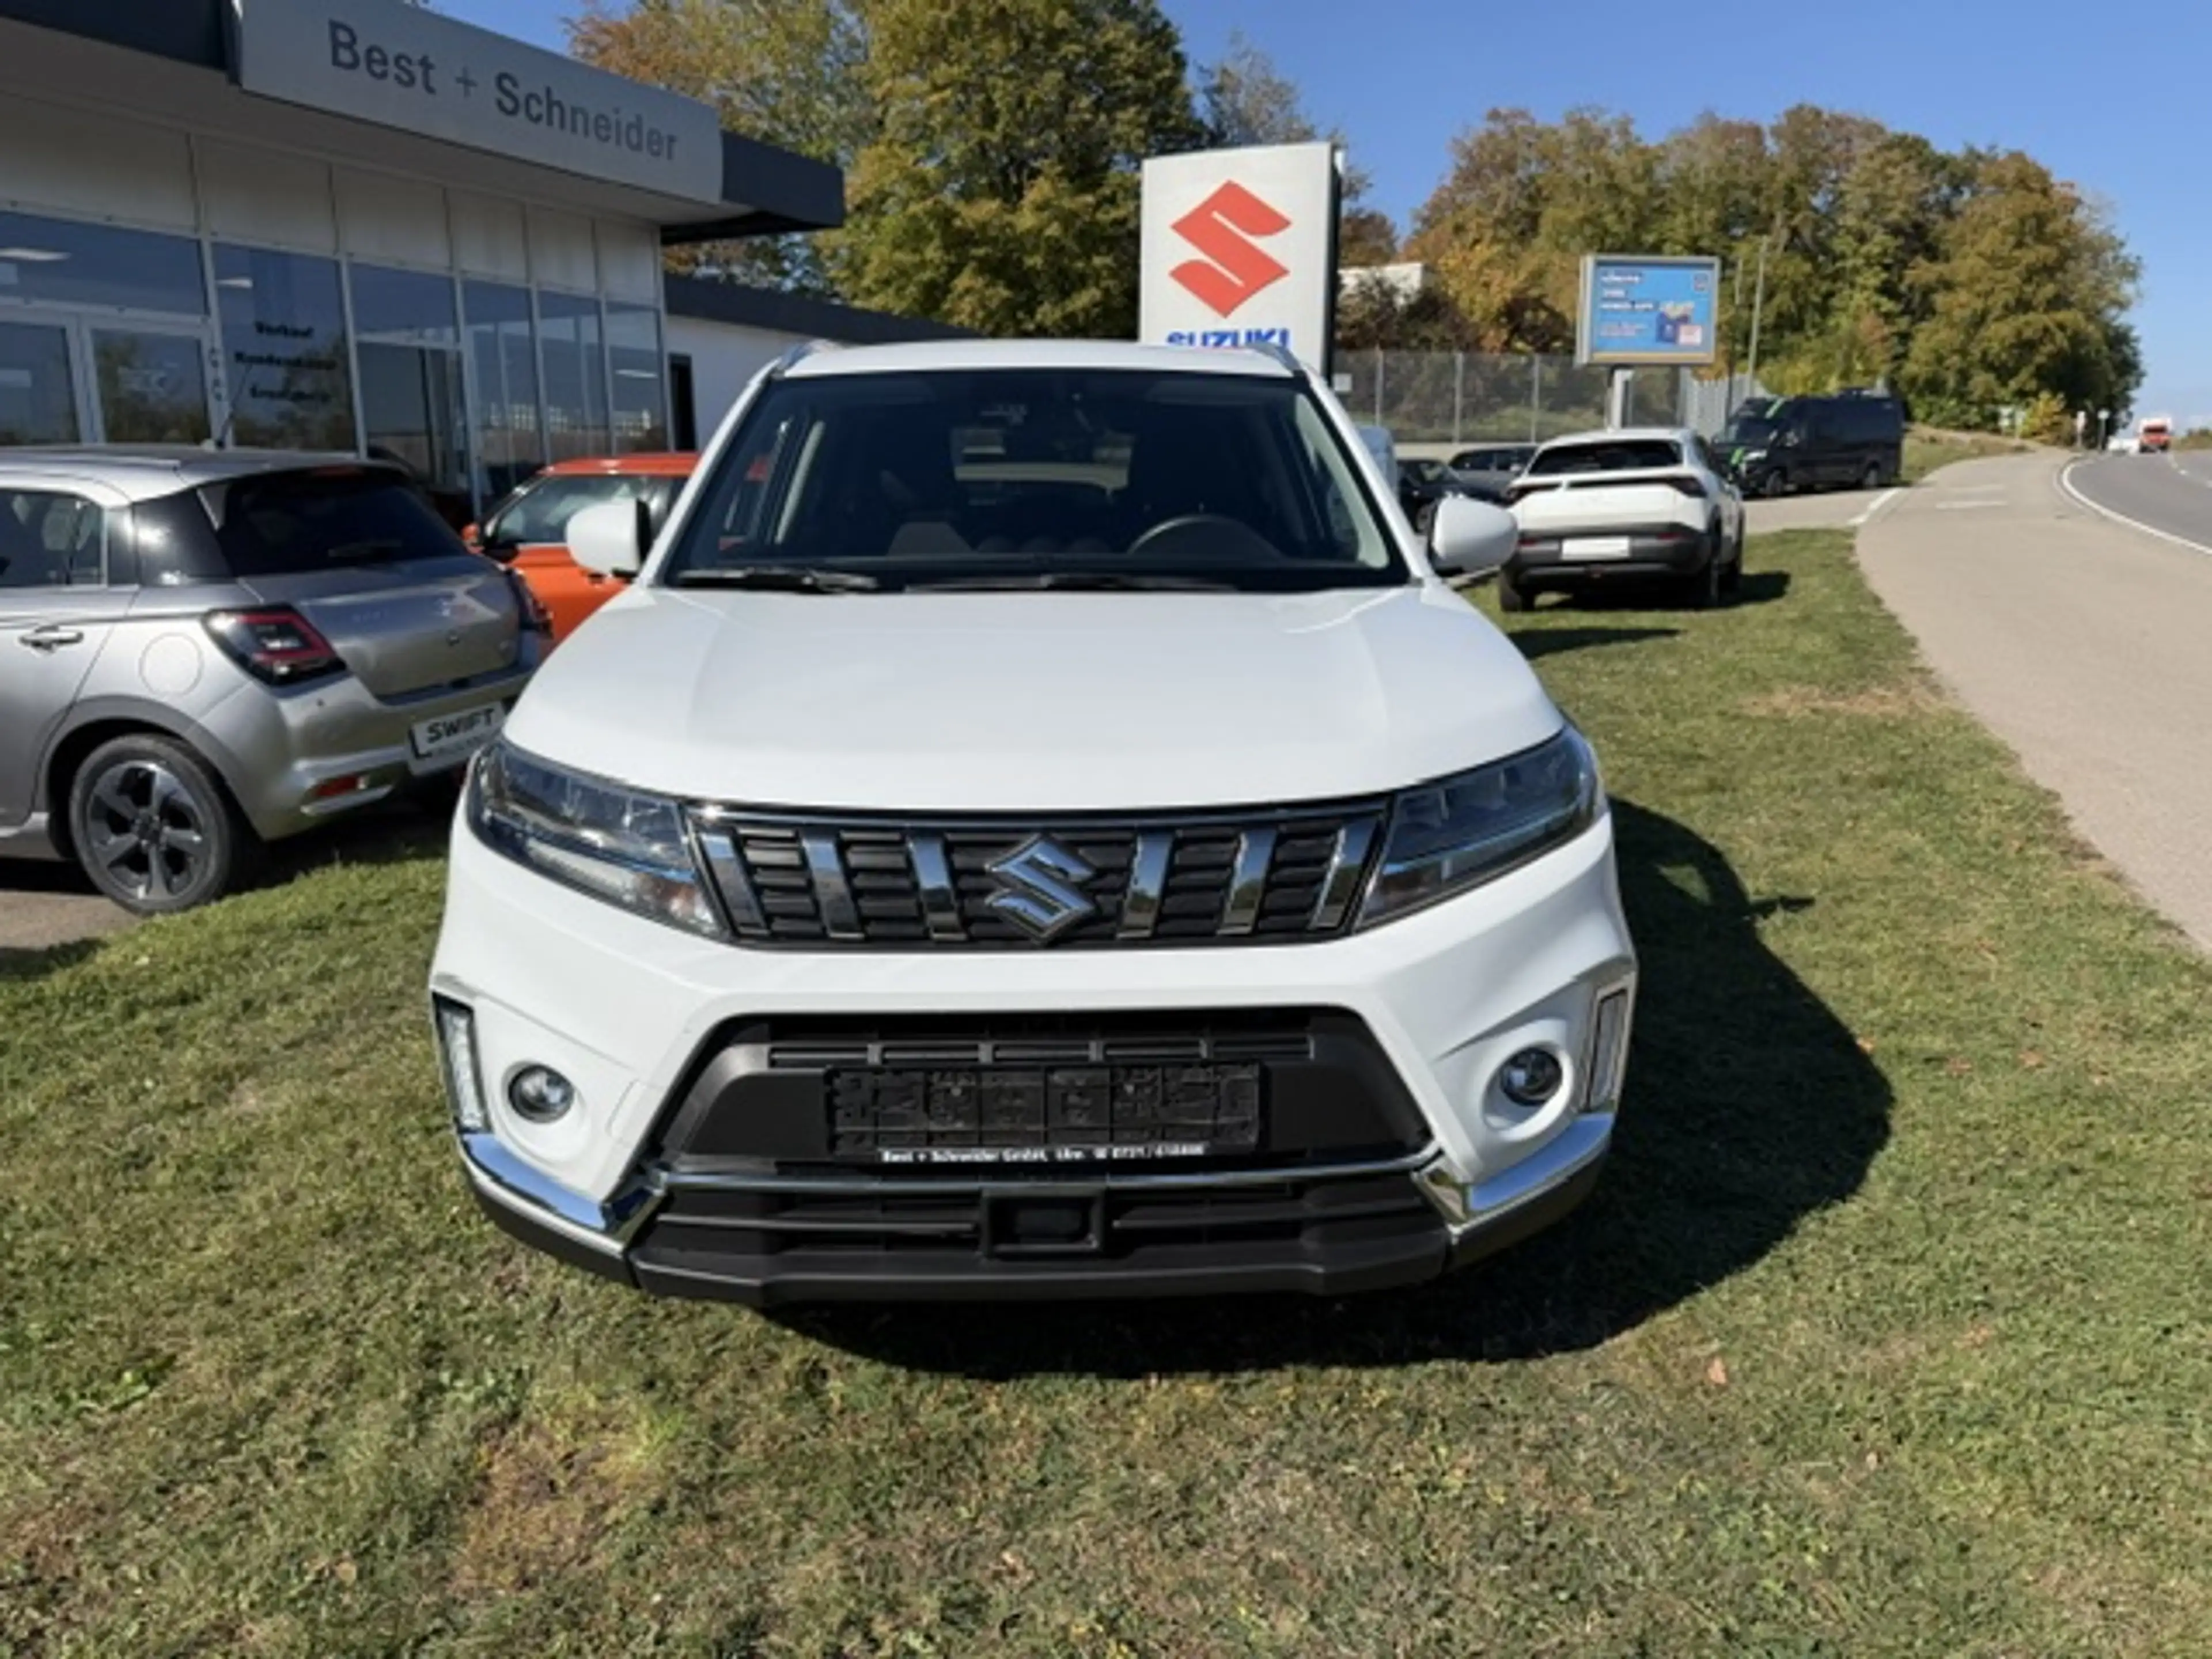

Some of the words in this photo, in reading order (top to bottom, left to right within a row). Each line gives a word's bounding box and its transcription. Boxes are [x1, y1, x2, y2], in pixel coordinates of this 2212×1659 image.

[328, 18, 437, 95] Best
[455, 67, 478, 99] +
[494, 70, 678, 162] Schneider
[1165, 327, 1290, 348] SUZUKI
[427, 707, 495, 744] SWIFT
